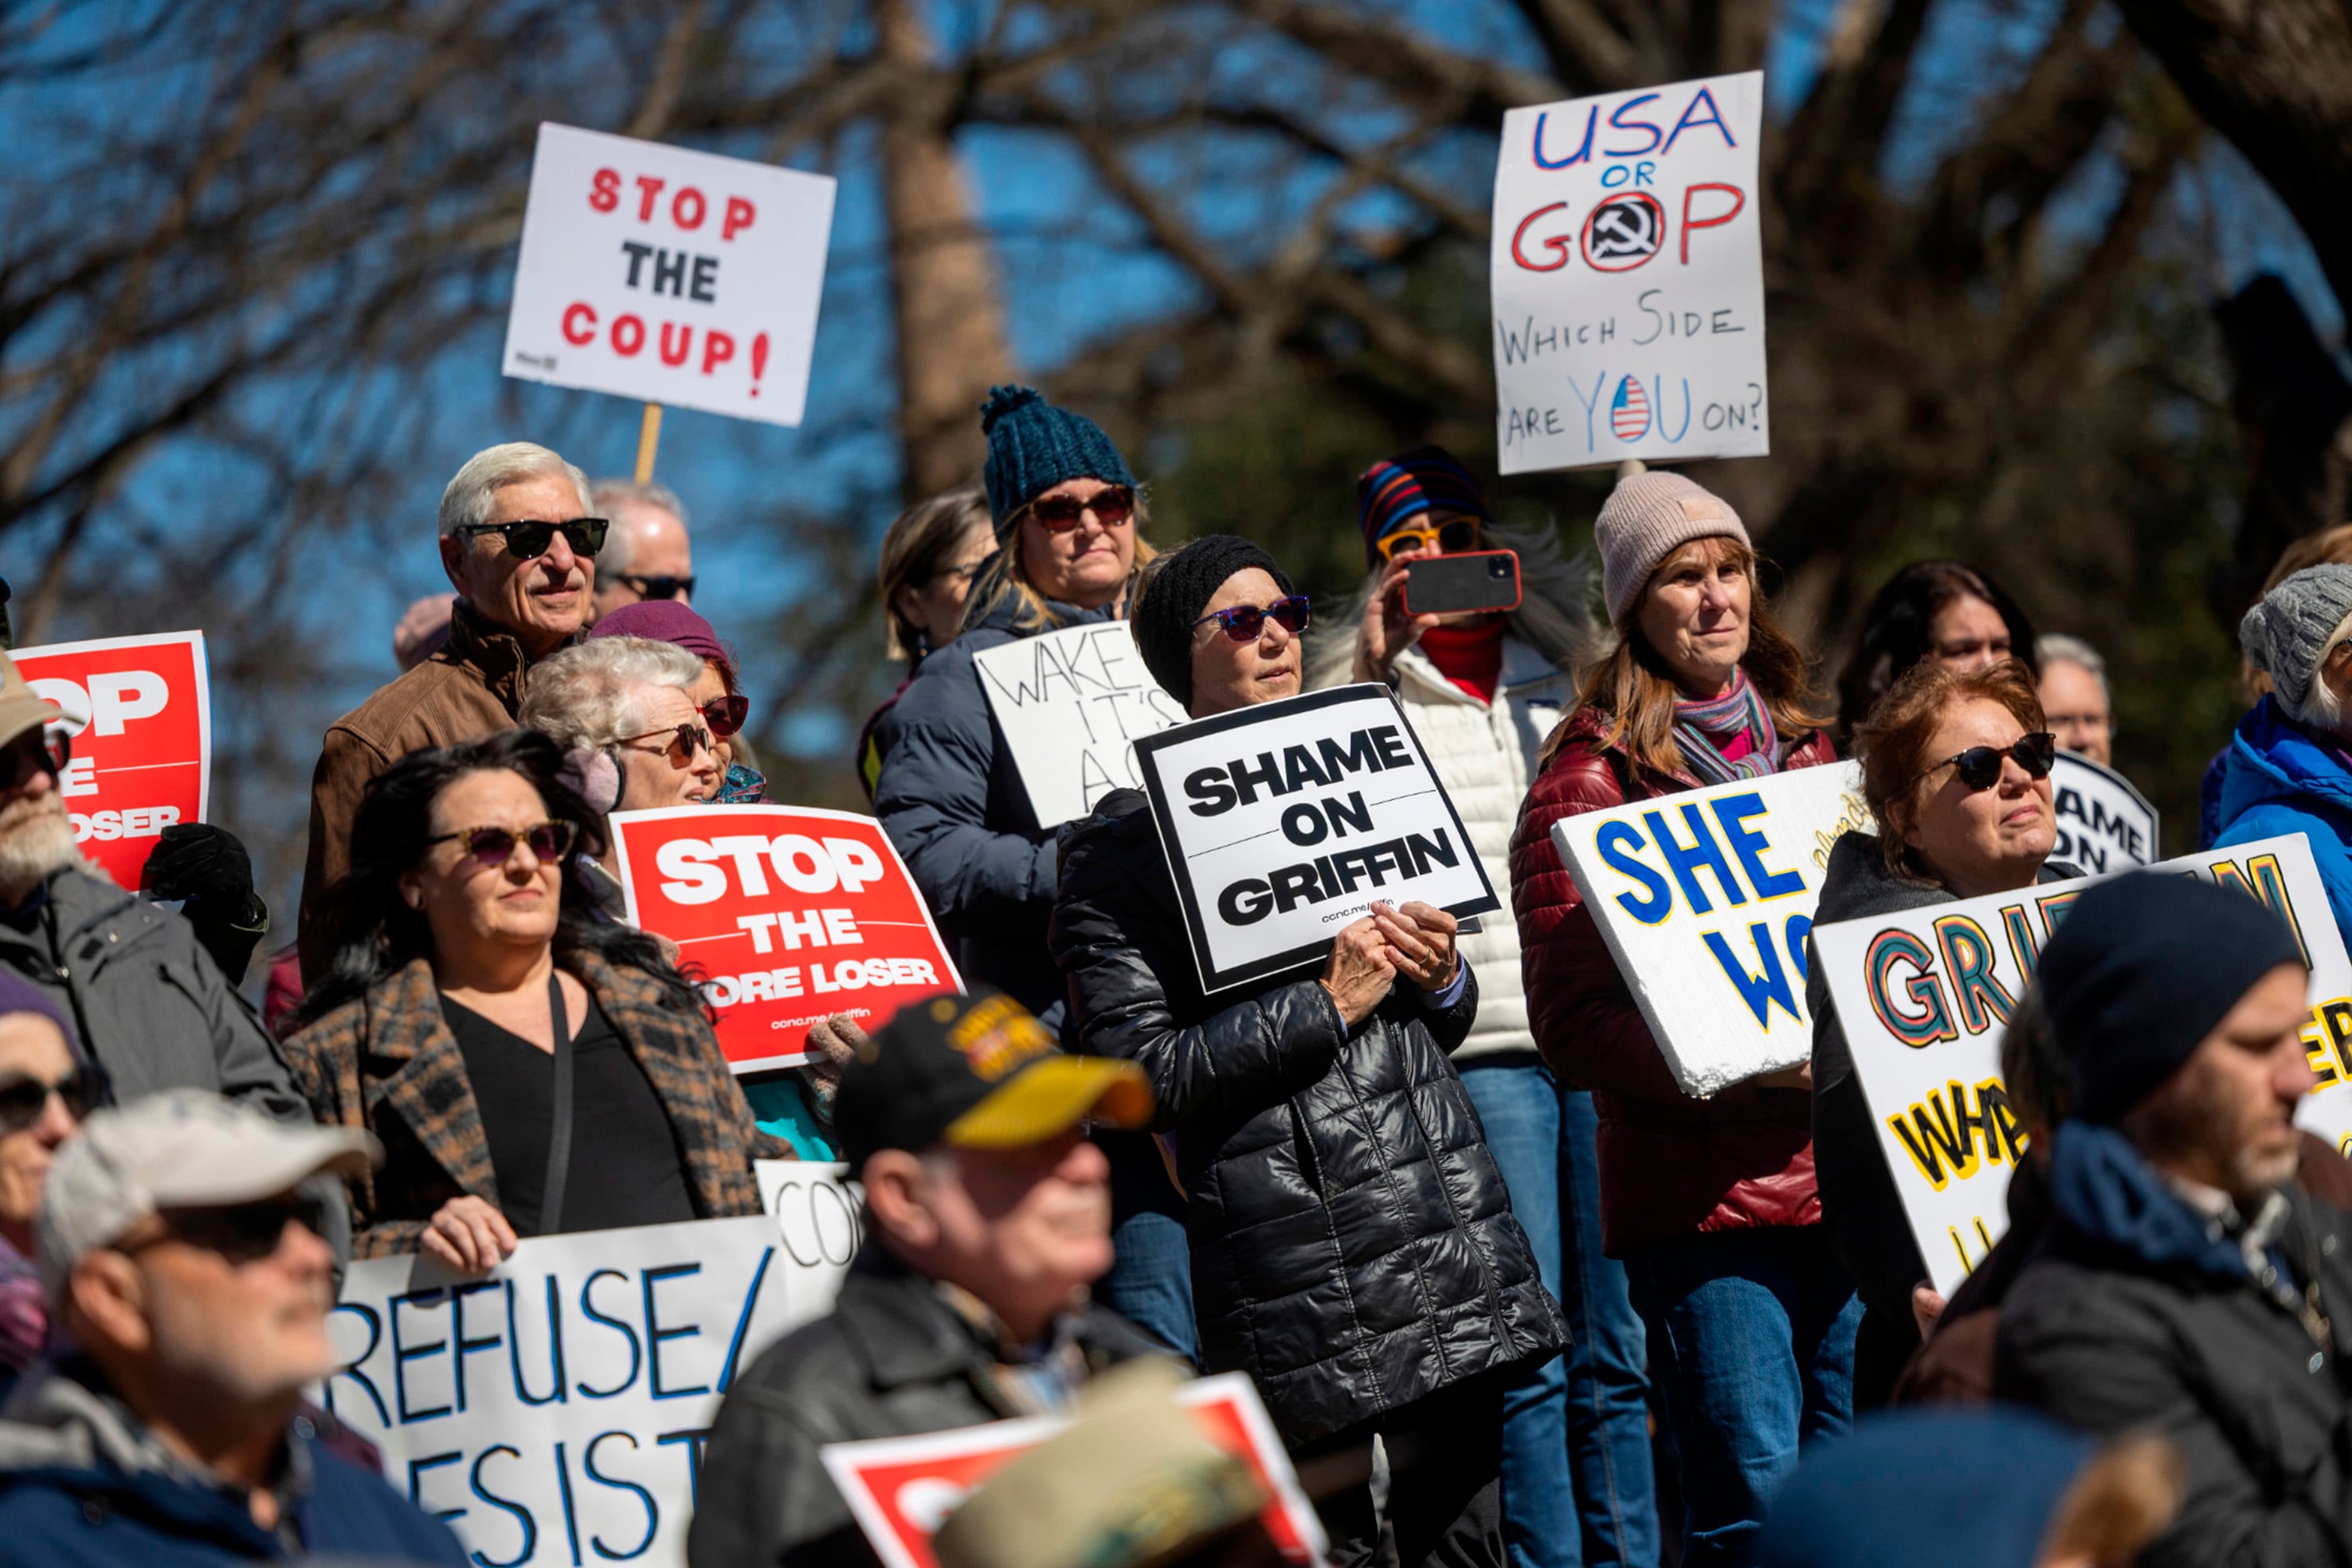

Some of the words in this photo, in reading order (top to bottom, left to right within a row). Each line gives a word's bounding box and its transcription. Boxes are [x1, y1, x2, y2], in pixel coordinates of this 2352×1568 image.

[1531, 84, 1738, 171] USA
[588, 167, 758, 241] STOP
[1600, 161, 1656, 188] OR
[1511, 182, 1746, 272] GOP
[621, 239, 720, 304] THE
[560, 300, 770, 399] COUP!
[1506, 406, 1565, 447] ARE
[1566, 370, 1691, 454] YOU
[1703, 382, 1763, 432] ON?
[24, 670, 169, 738] OP
[978, 627, 1142, 708] WAKE
[1182, 724, 1415, 817] SHAME
[68, 805, 181, 844] OSER
[1280, 790, 1375, 847] ON
[1592, 790, 1809, 927] SHE
[2055, 785, 2146, 866] AME
[655, 833, 884, 906] STOP
[1217, 827, 1460, 927] GRIFFIN
[736, 908, 864, 955] THE
[692, 966, 804, 1009] ORE
[810, 958, 941, 994] LOSER
[409, 1428, 714, 1568] ESIST
